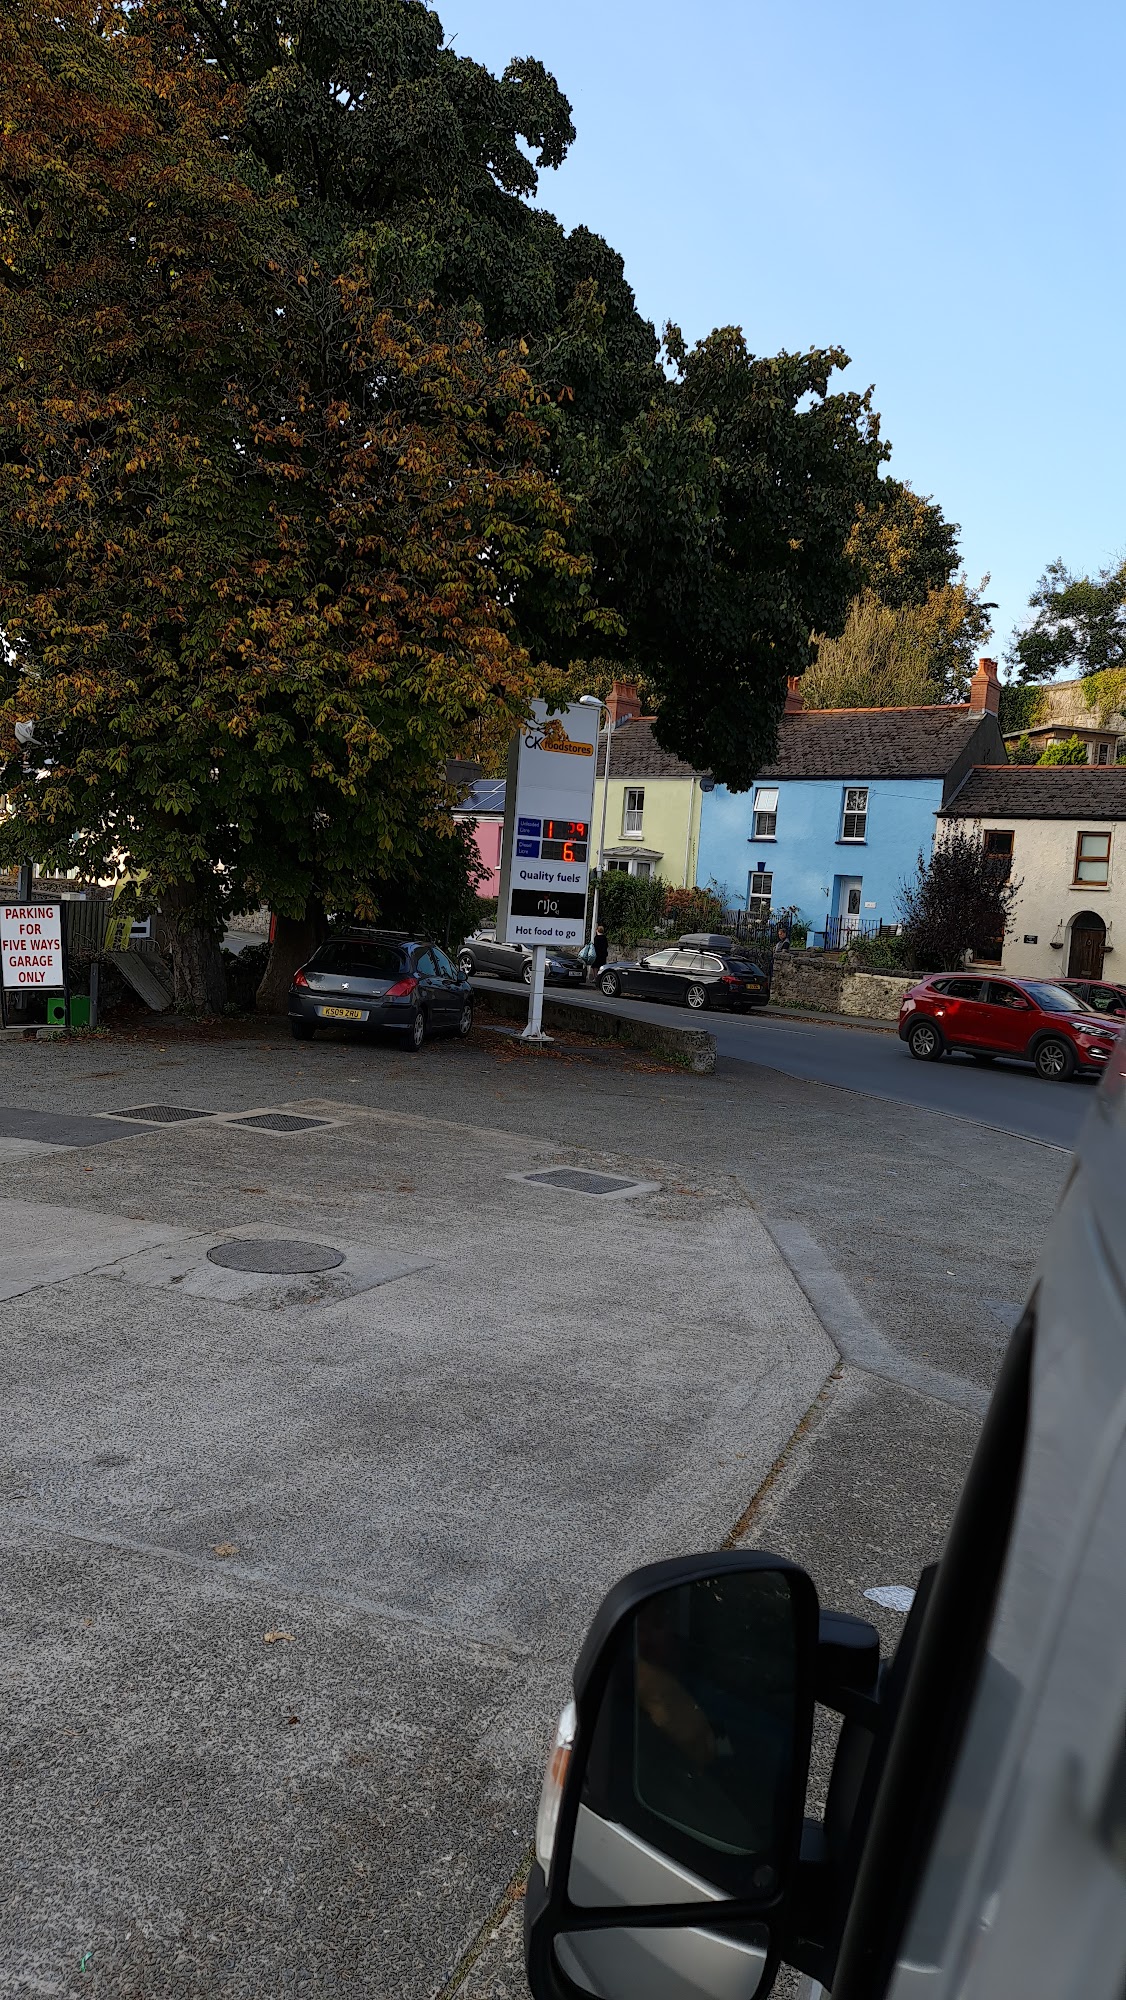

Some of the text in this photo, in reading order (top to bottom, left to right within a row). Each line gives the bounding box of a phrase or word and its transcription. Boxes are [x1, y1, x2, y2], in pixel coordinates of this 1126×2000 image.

[525, 735, 591, 754] CK foodstores
[520, 870, 580, 883] Quality fuels
[537, 898, 557, 914] rijo
[5, 907, 54, 919] PARKING
[19, 923, 42, 935] FOR
[515, 926, 576, 939] Hot food to go
[2, 939, 60, 951] FIVE WAYS
[9, 955, 53, 967] GARAGE
[18, 971, 46, 983] ONLY
